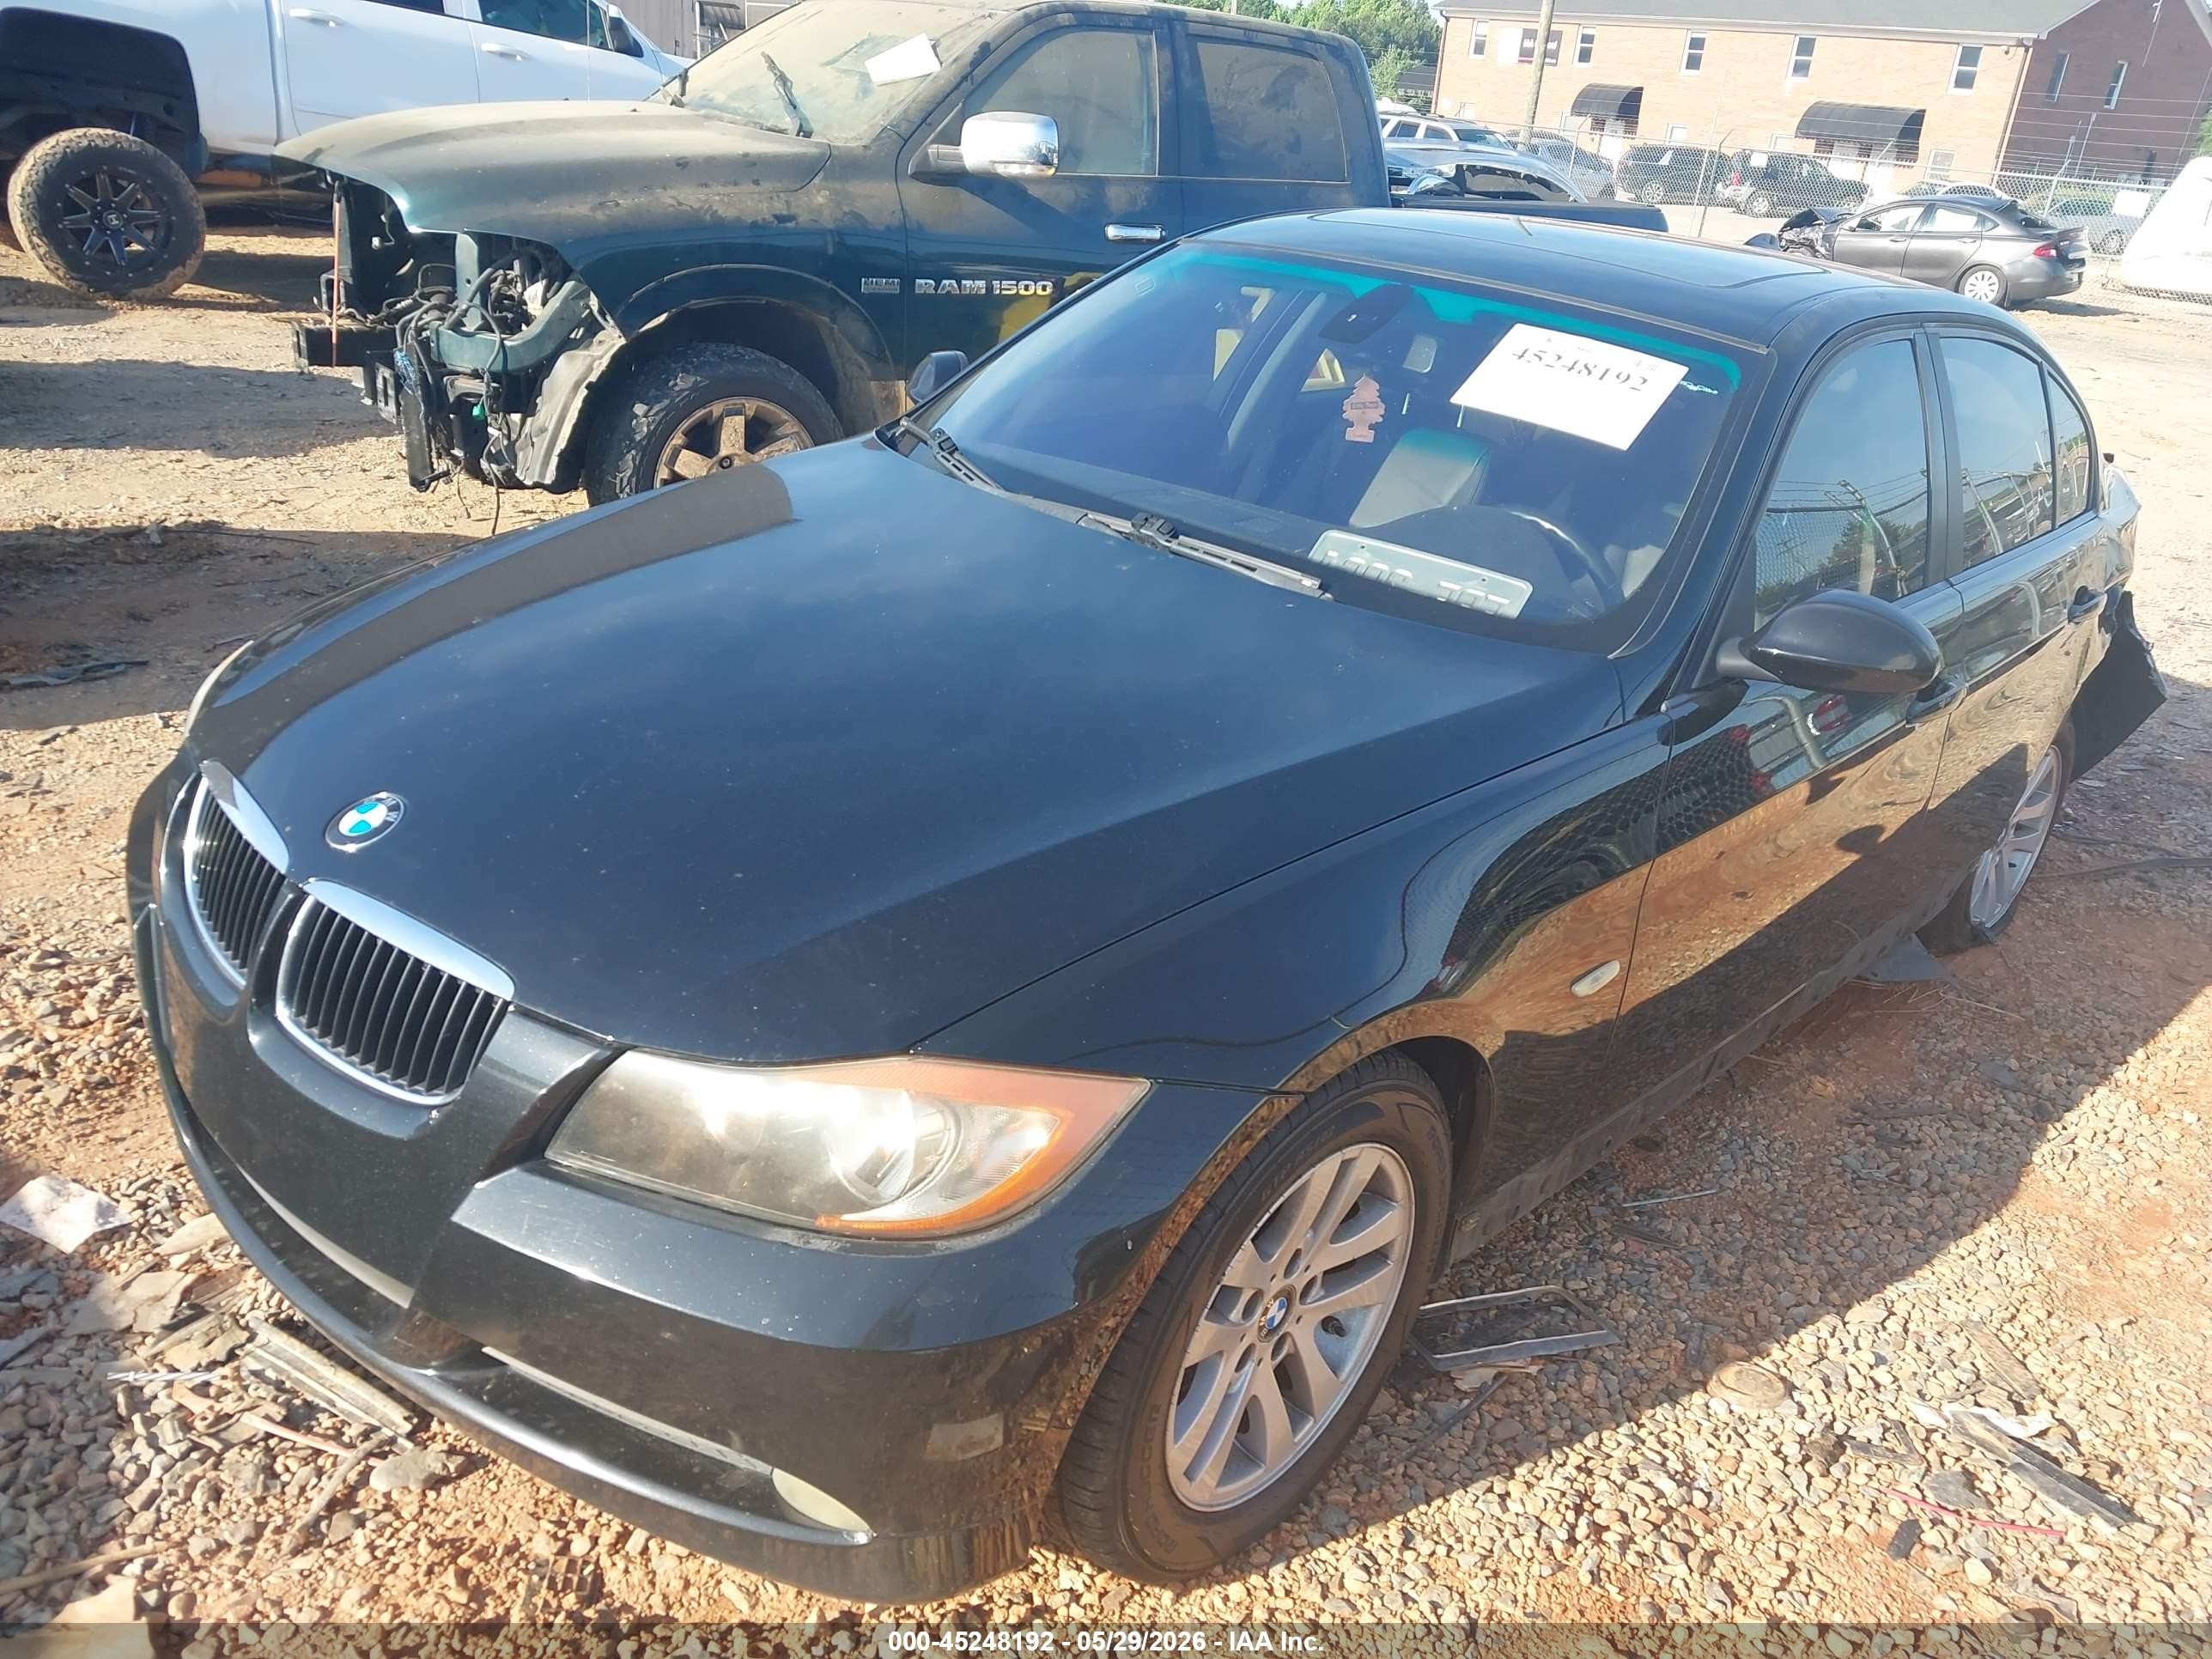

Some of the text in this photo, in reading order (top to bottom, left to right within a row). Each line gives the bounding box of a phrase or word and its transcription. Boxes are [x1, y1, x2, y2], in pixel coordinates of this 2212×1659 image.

[915, 278, 1054, 296] RAM 1500
[1511, 347, 1649, 392] 45248192
